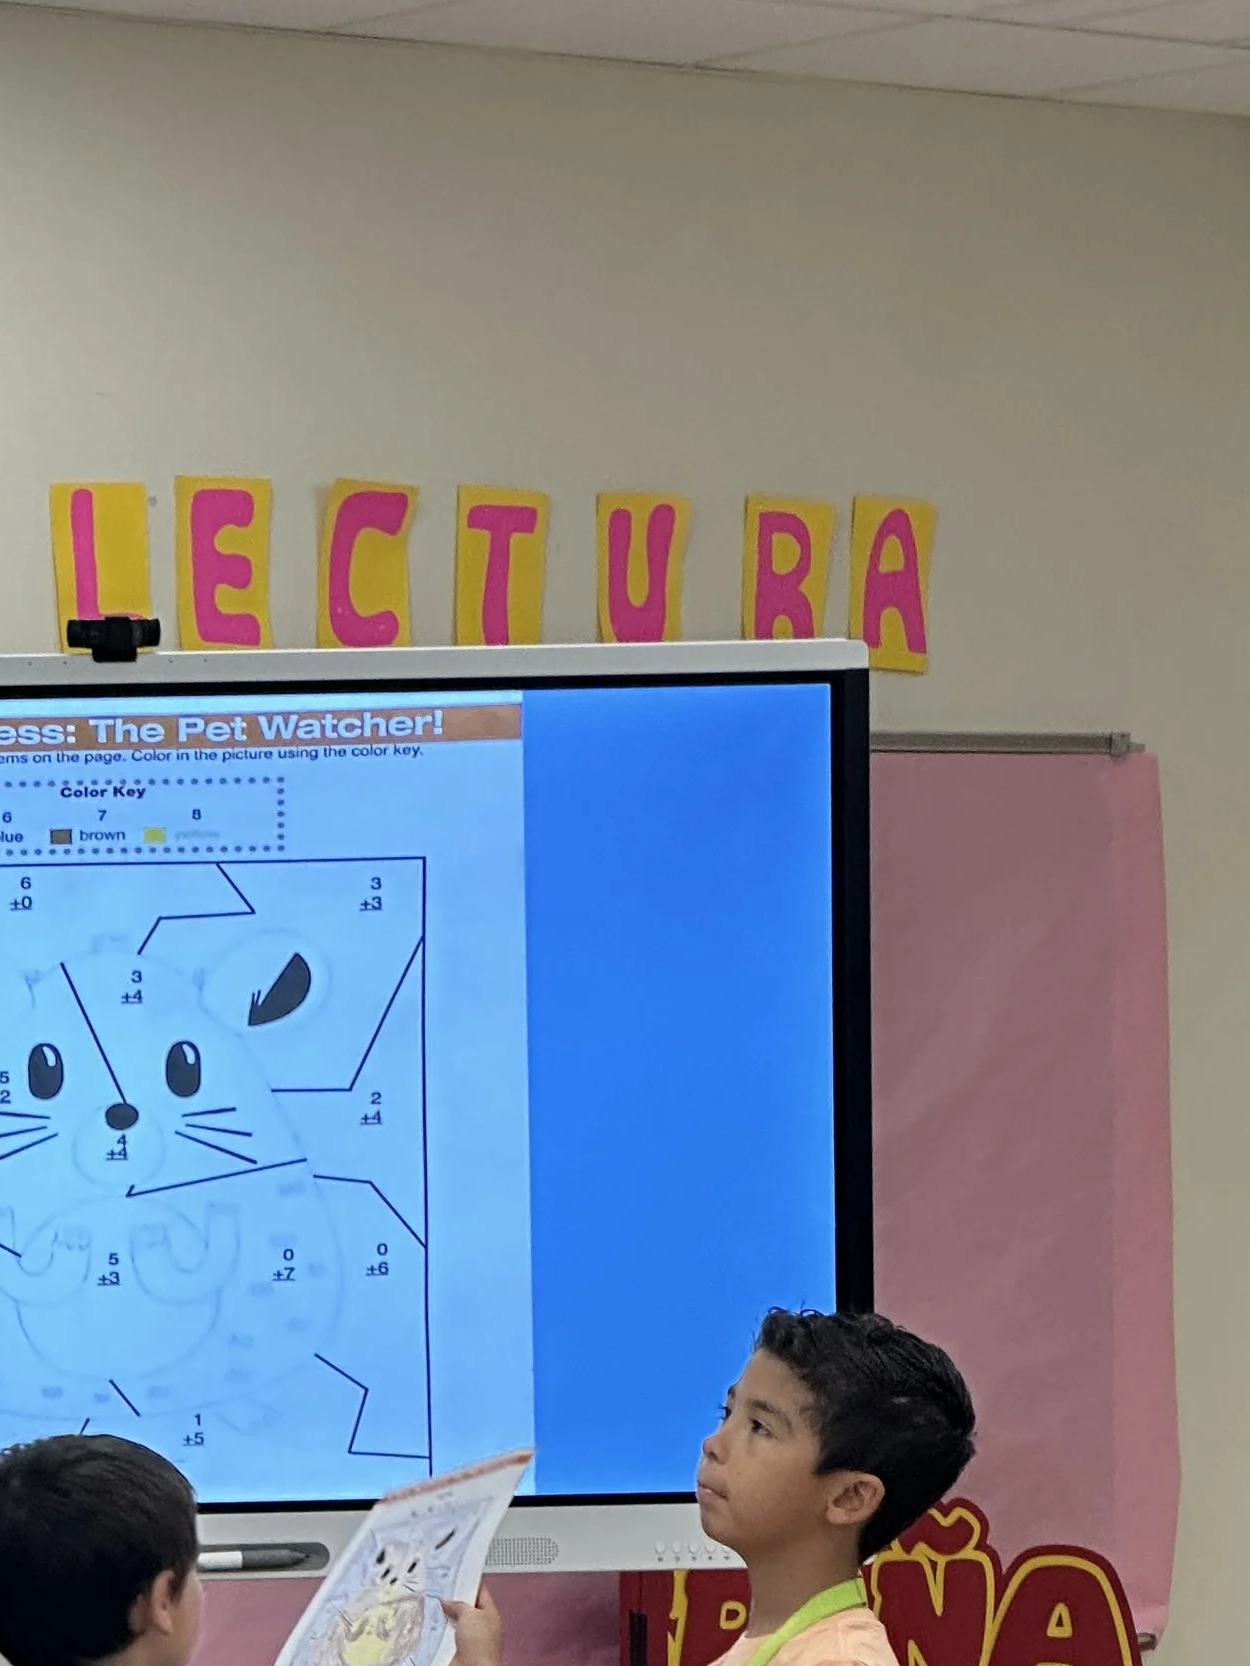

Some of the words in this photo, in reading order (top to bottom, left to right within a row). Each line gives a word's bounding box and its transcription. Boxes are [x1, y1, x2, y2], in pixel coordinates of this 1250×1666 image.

[70, 486, 927, 652] LECTURA
[88, 718, 165, 744] The
[177, 716, 247, 743] Pet
[258, 709, 443, 740] Watcher!
[33, 754, 51, 765] on
[57, 751, 80, 764] the
[84, 752, 126, 767] page.
[131, 750, 175, 762] Color
[180, 749, 190, 761] in
[195, 749, 217, 760] the
[223, 747, 272, 763] picture
[278, 747, 318, 762] using
[324, 746, 346, 758] the
[351, 745, 387, 757] color
[393, 743, 423, 759] key.
[61, 786, 107, 798] Color
[113, 785, 146, 799] Key
[2, 811, 12, 824] 6
[98, 809, 107, 821] 7
[192, 809, 201, 821] 8
[79, 829, 126, 842] brown
[21, 876, 32, 891] 6
[371, 876, 382, 891] 3
[131, 970, 143, 984] 3
[0, 1070, 10, 1084] 5
[371, 1091, 382, 1105] 2
[116, 1134, 127, 1148] 4
[283, 1248, 294, 1262] 0
[377, 1243, 388, 1256] 0
[108, 1252, 120, 1265] 5
[194, 1413, 201, 1427] 1
